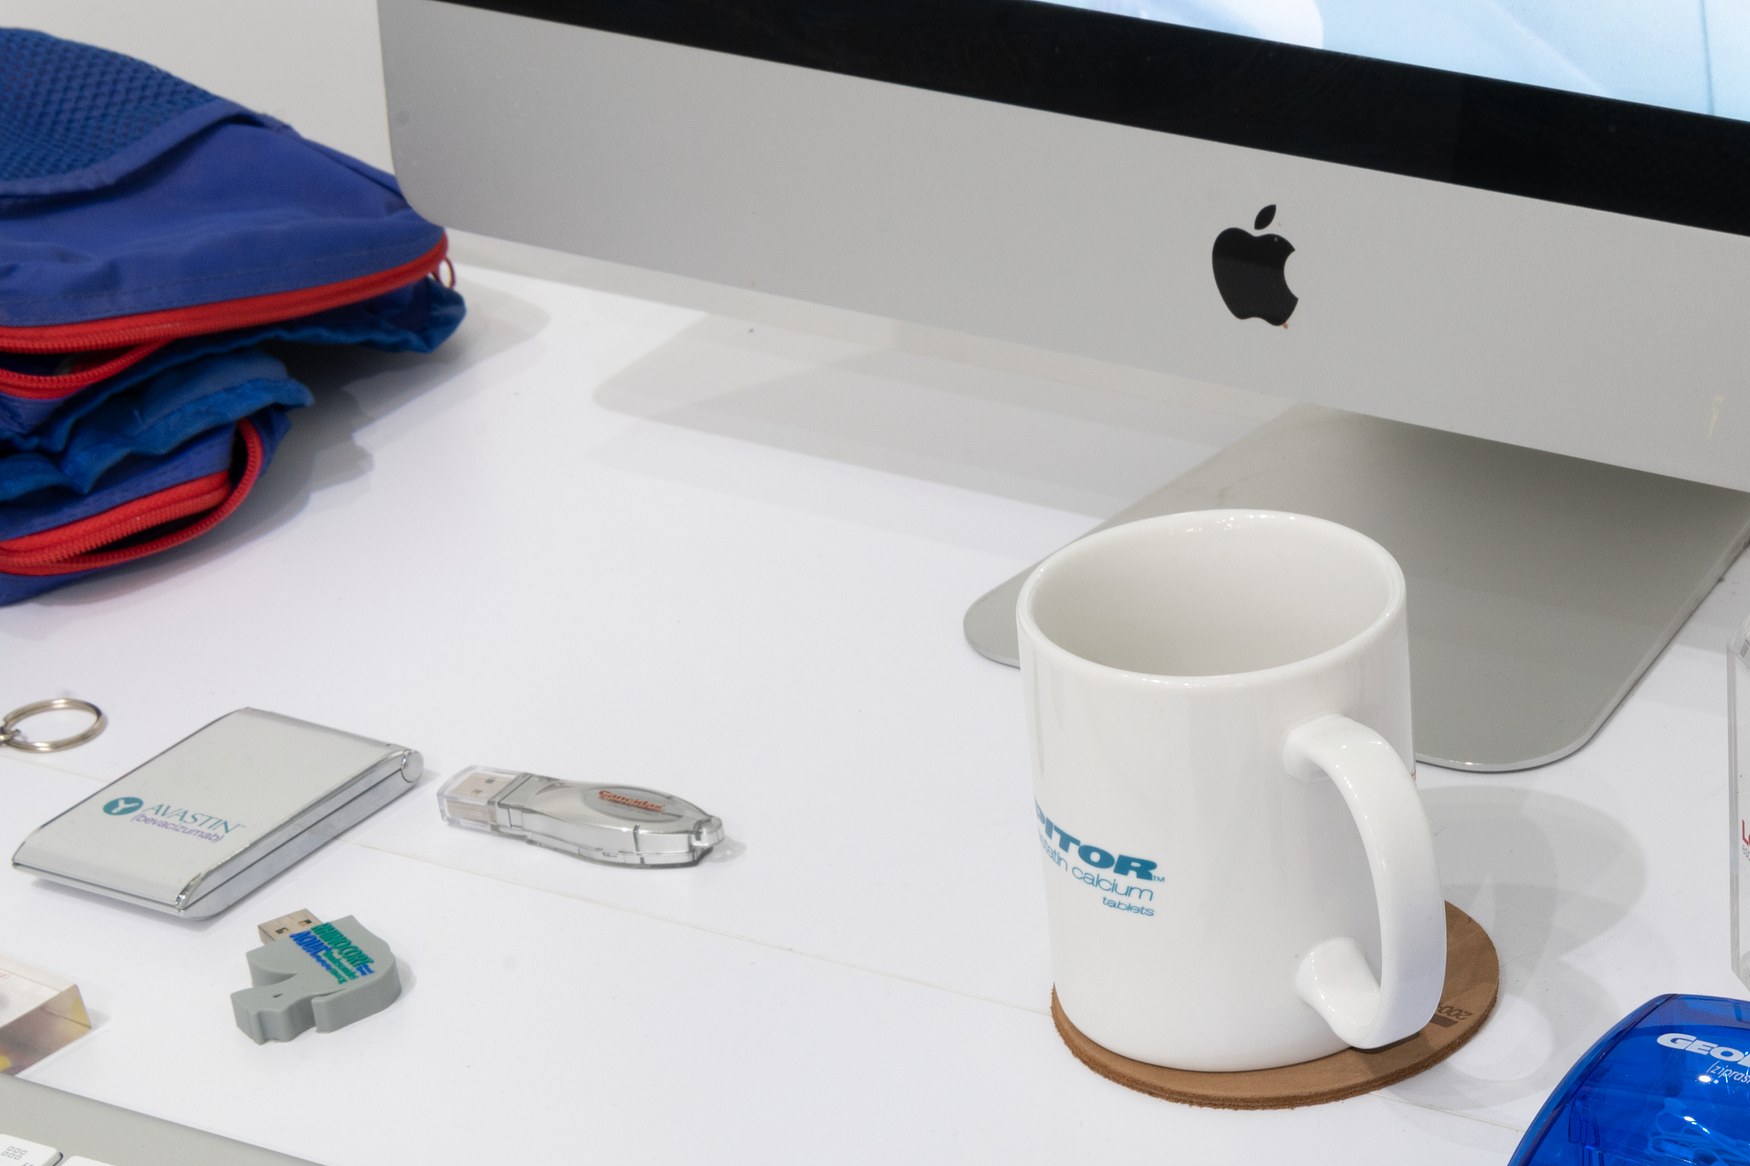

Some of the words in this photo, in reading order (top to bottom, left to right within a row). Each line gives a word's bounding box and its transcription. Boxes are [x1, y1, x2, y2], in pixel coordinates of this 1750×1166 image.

[142, 803, 241, 833] AVASTIN
[1072, 866, 1154, 901] calcium
[1102, 896, 1155, 916] tablets
